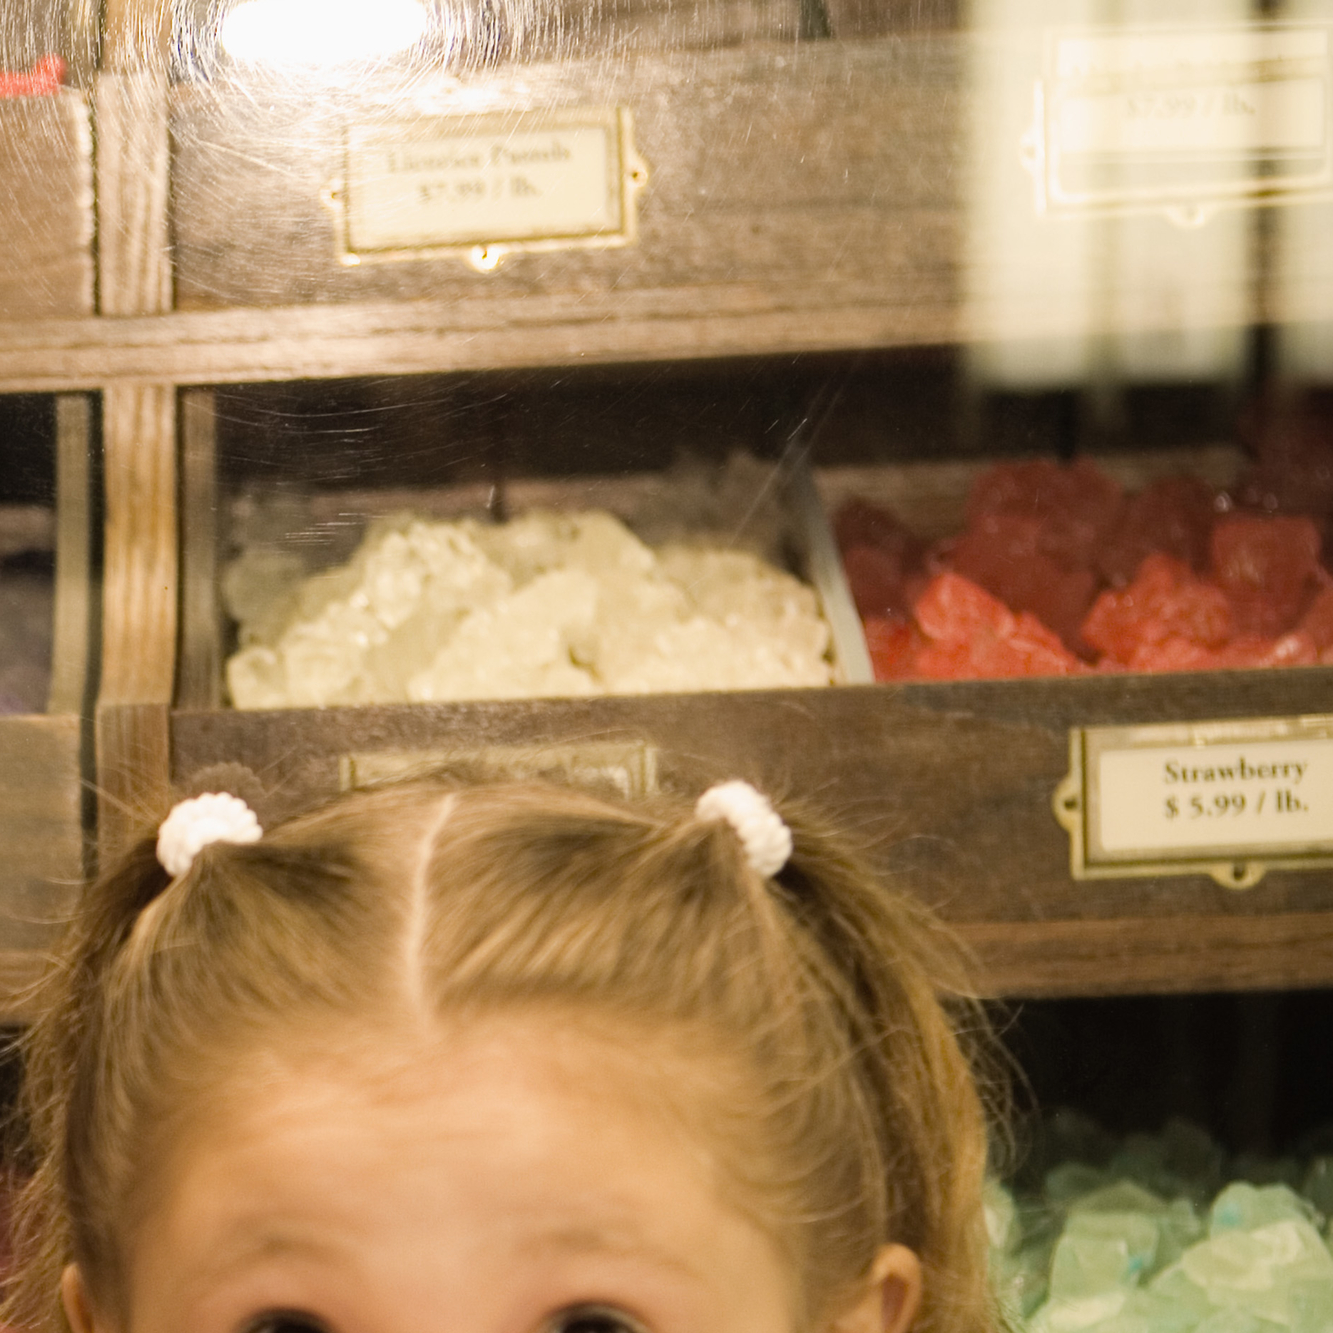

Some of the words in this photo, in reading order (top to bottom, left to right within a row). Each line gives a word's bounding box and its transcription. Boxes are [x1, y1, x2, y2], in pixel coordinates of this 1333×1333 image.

[1165, 756, 1308, 784] Strawberry
[1165, 796, 1179, 820] $
[1190, 793, 1246, 818] 5.99
[1256, 791, 1266, 813] /
[1276, 789, 1309, 812] lb.
